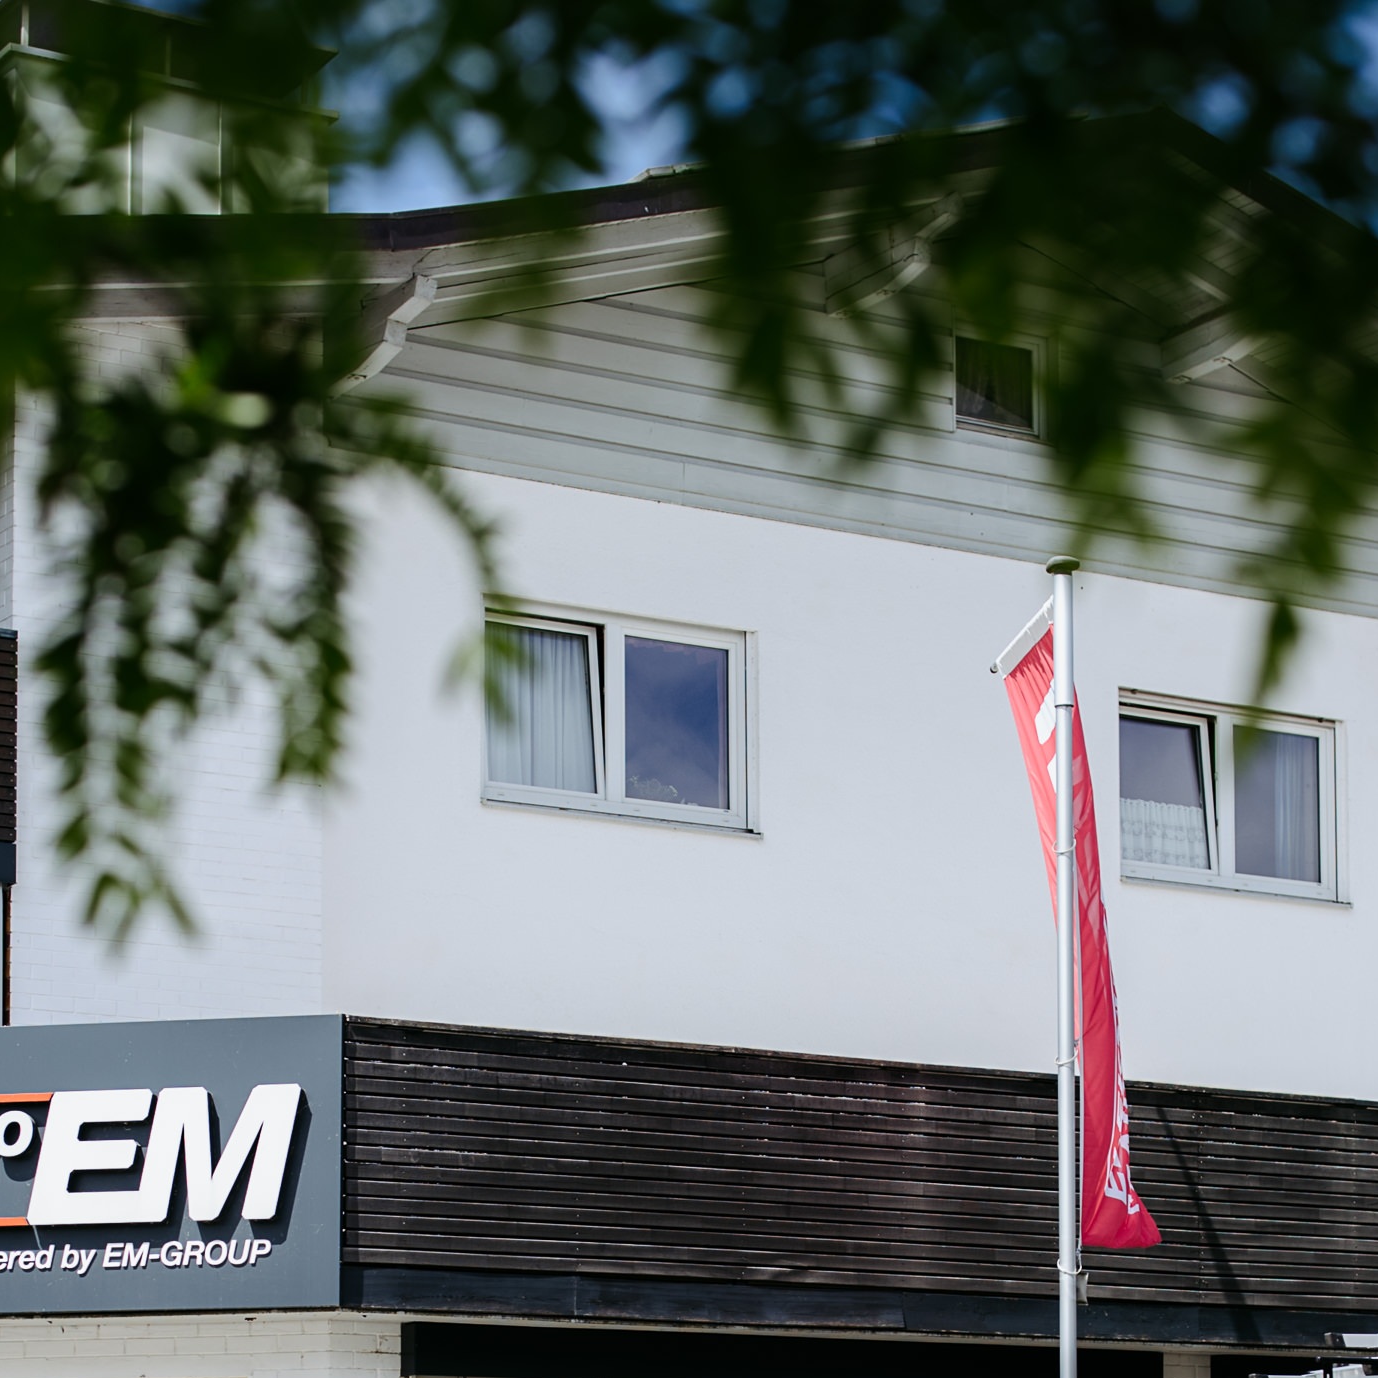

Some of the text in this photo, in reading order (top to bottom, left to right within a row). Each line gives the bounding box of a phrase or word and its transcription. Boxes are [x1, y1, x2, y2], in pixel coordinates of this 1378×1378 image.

[25, 1083, 303, 1225] EM
[61, 1244, 97, 1275] by
[102, 1239, 272, 1271] EM-GROUP
